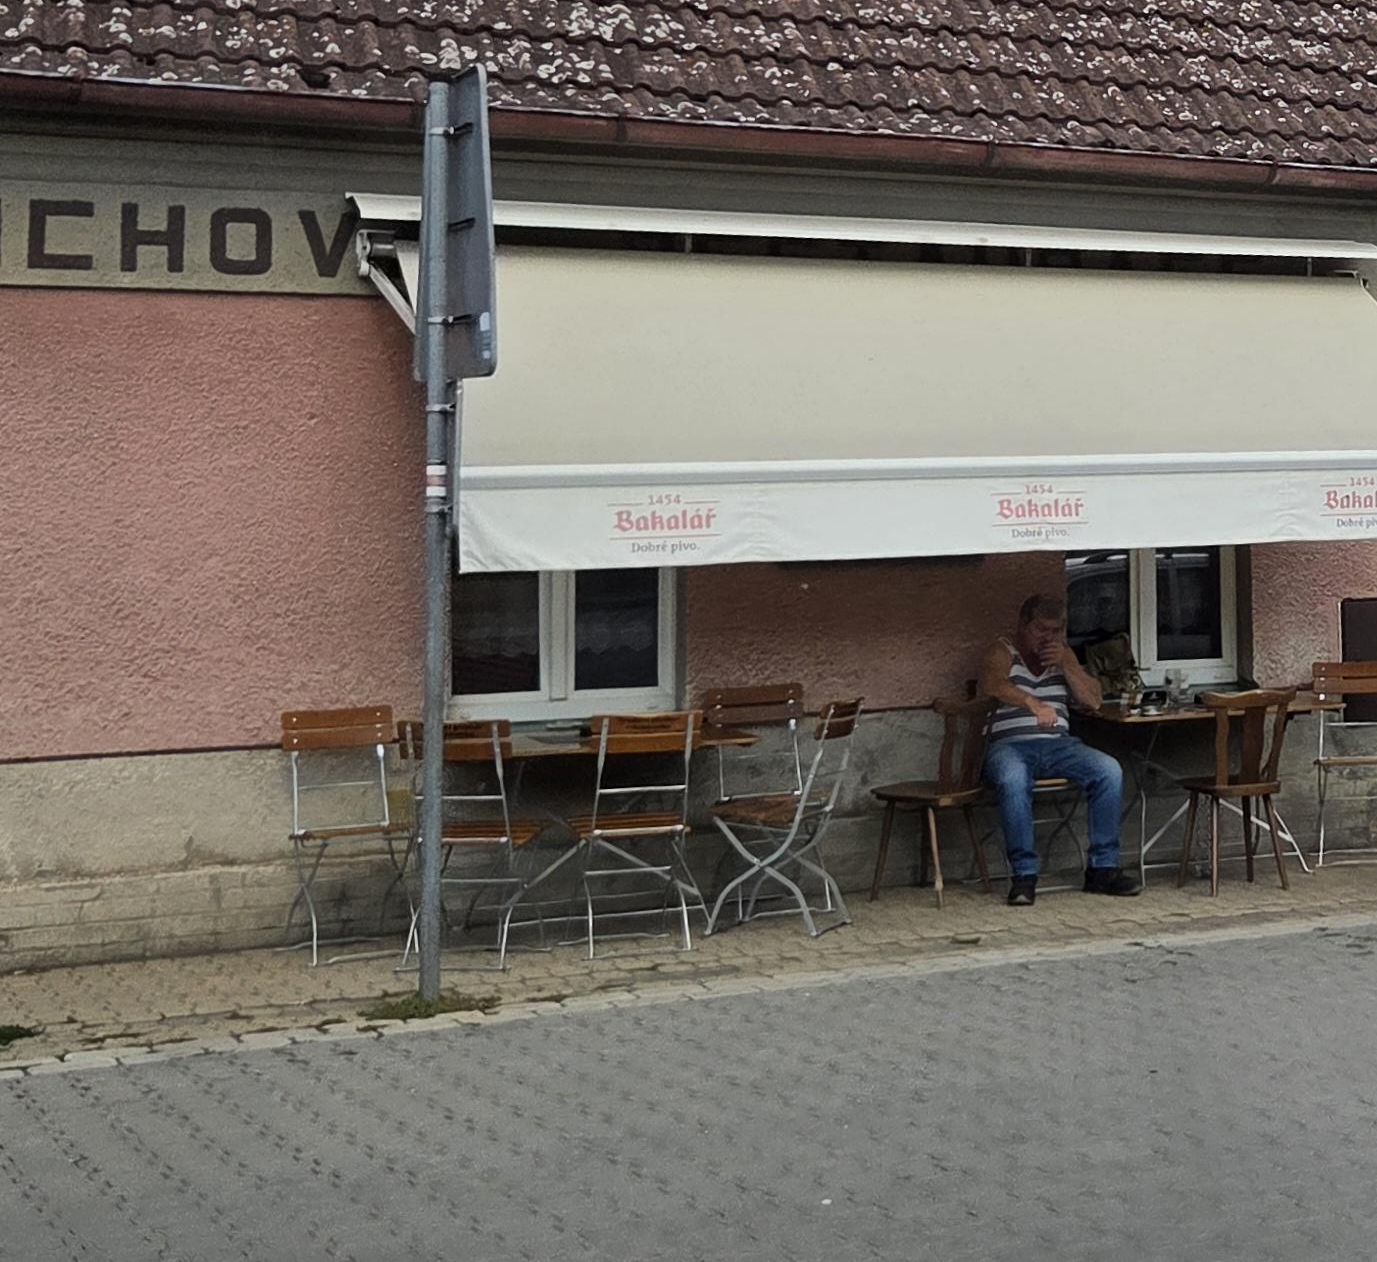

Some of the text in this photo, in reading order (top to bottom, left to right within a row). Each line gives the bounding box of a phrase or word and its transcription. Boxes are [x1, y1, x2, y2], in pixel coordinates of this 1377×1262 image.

[0, 198, 355, 278] CHOV
[1349, 477, 1375, 487] 1454
[1024, 484, 1054, 495] 1454
[648, 494, 681, 506] 1454
[996, 498, 1084, 519] Bakalář
[613, 508, 717, 532] Bakalář
[1336, 518, 1364, 528] Dobré
[1011, 528, 1043, 539] Dobré
[631, 540, 701, 554] Dobré pivo.
